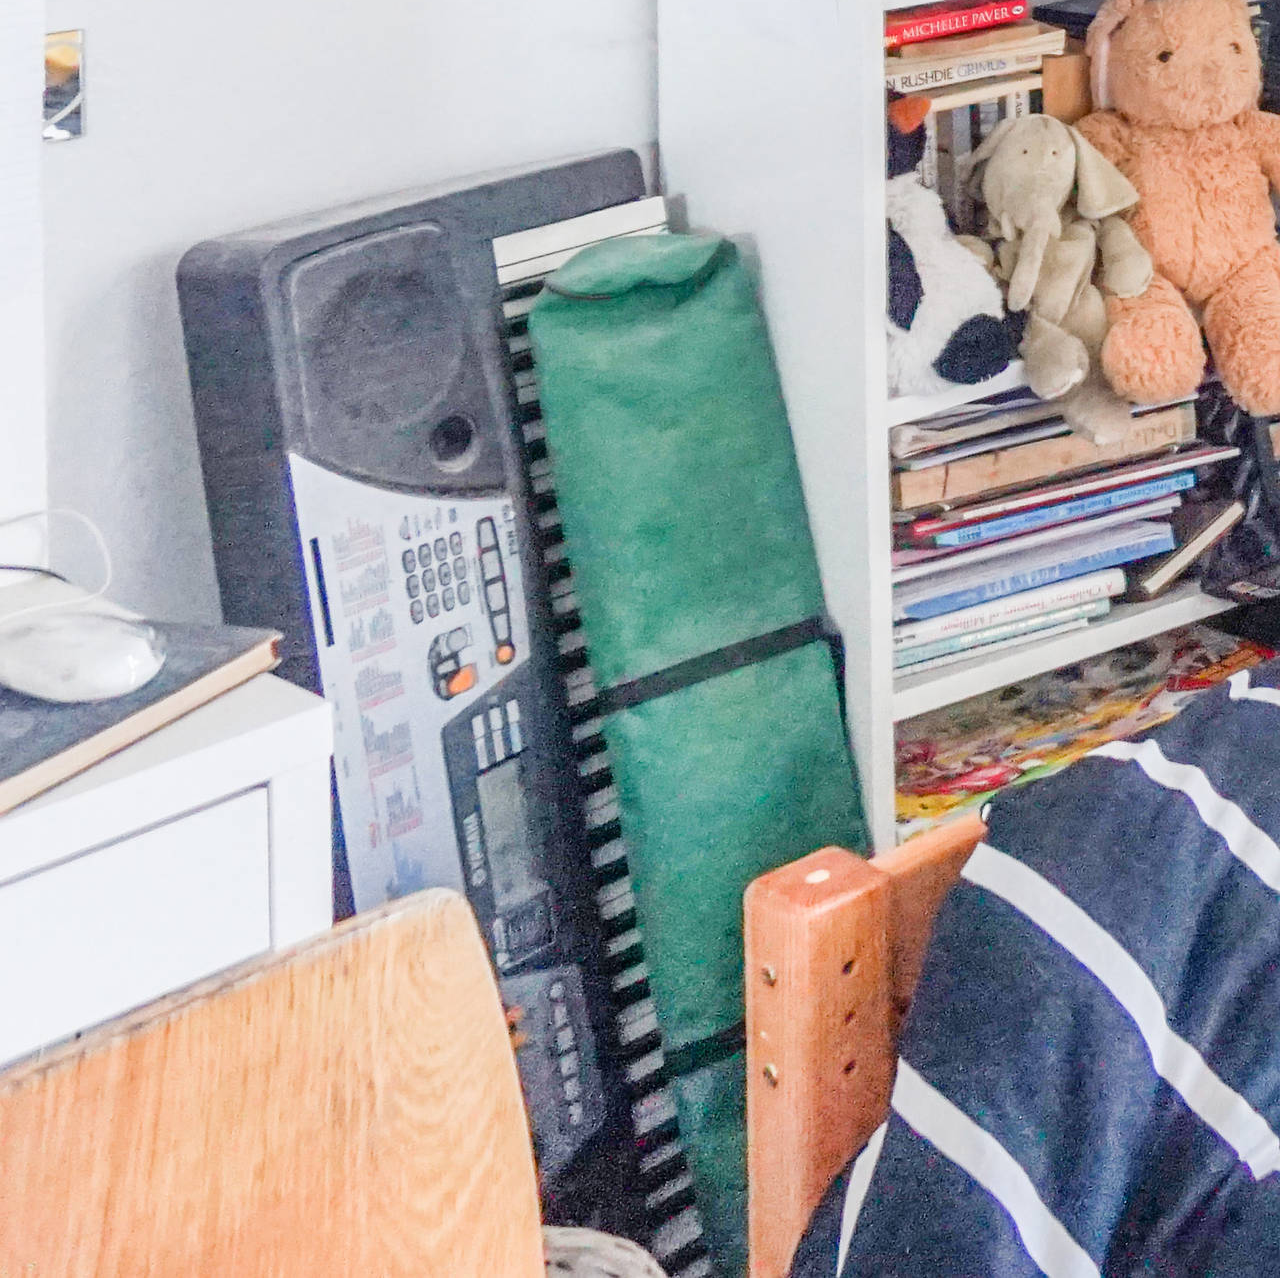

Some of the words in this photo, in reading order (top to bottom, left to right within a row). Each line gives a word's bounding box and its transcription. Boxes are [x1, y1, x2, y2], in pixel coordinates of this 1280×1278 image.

[902, 14, 969, 40] MICHELLE
[971, 6, 1011, 26] PAVER
[900, 67, 954, 89] RUSHDIE
[956, 59, 1007, 78] GRIMUS
